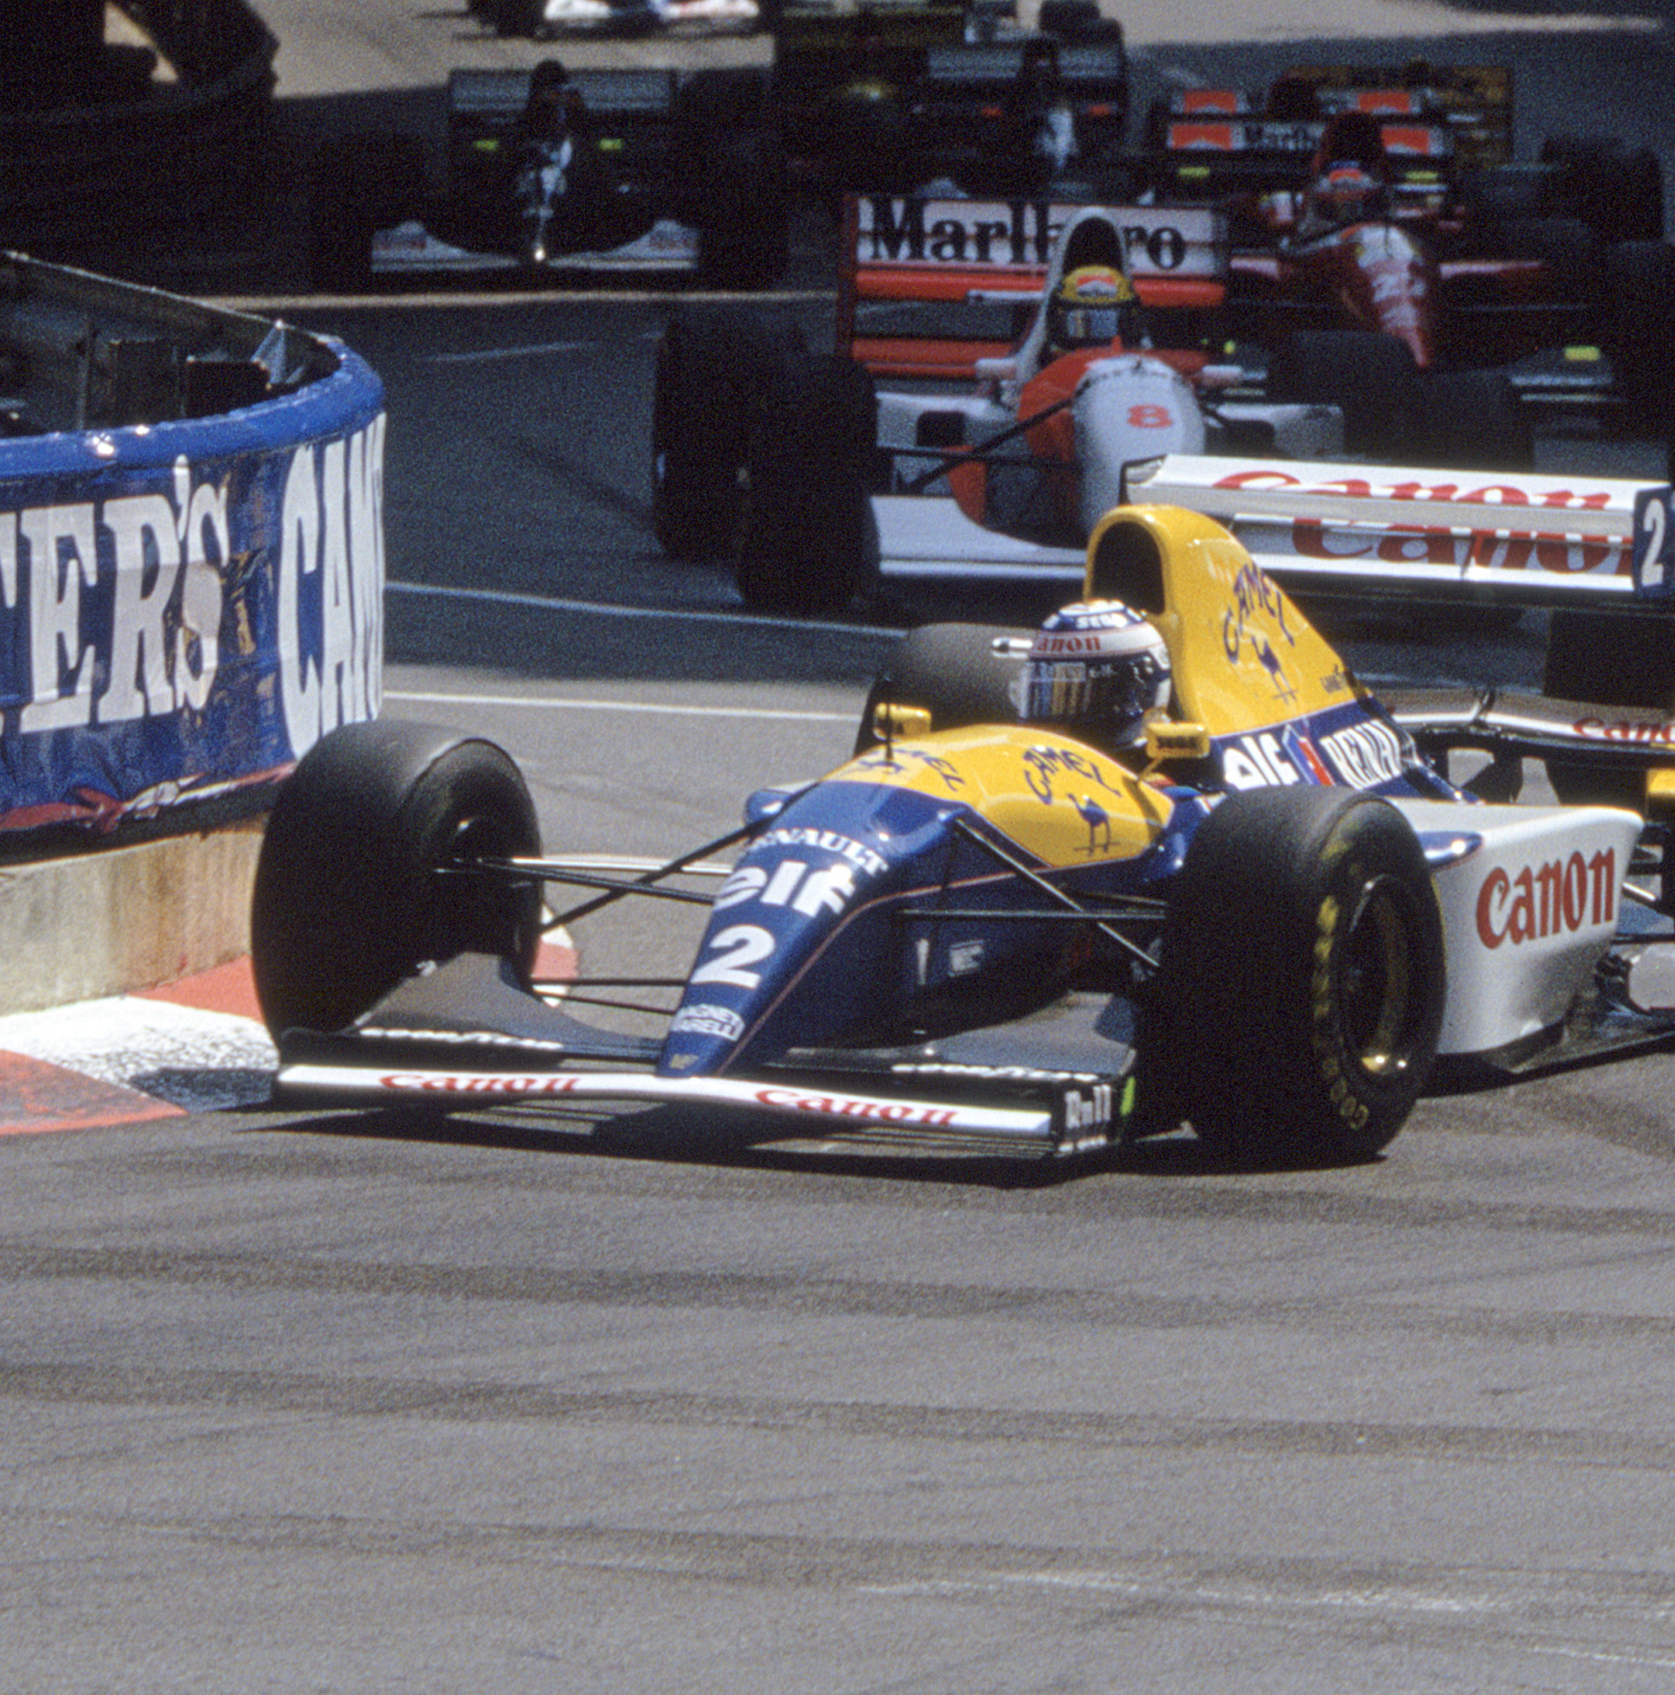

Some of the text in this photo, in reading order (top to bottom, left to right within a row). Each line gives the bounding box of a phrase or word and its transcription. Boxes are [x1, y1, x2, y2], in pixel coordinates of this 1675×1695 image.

[870, 196, 1187, 270] Marlbro
[1128, 405, 1173, 428] 8
[1291, 517, 1635, 574] Cano
[1641, 499, 1666, 587] 2
[1224, 562, 1295, 665] CAMEL
[1036, 636, 1101, 653] anon
[1023, 745, 1123, 806] CAMEL
[749, 828, 889, 876] NAULT
[712, 860, 856, 918] elf
[1477, 846, 1616, 950] Canon
[689, 924, 776, 990] 2
[378, 1074, 581, 1092] Canon
[755, 1089, 960, 1127] Canon
